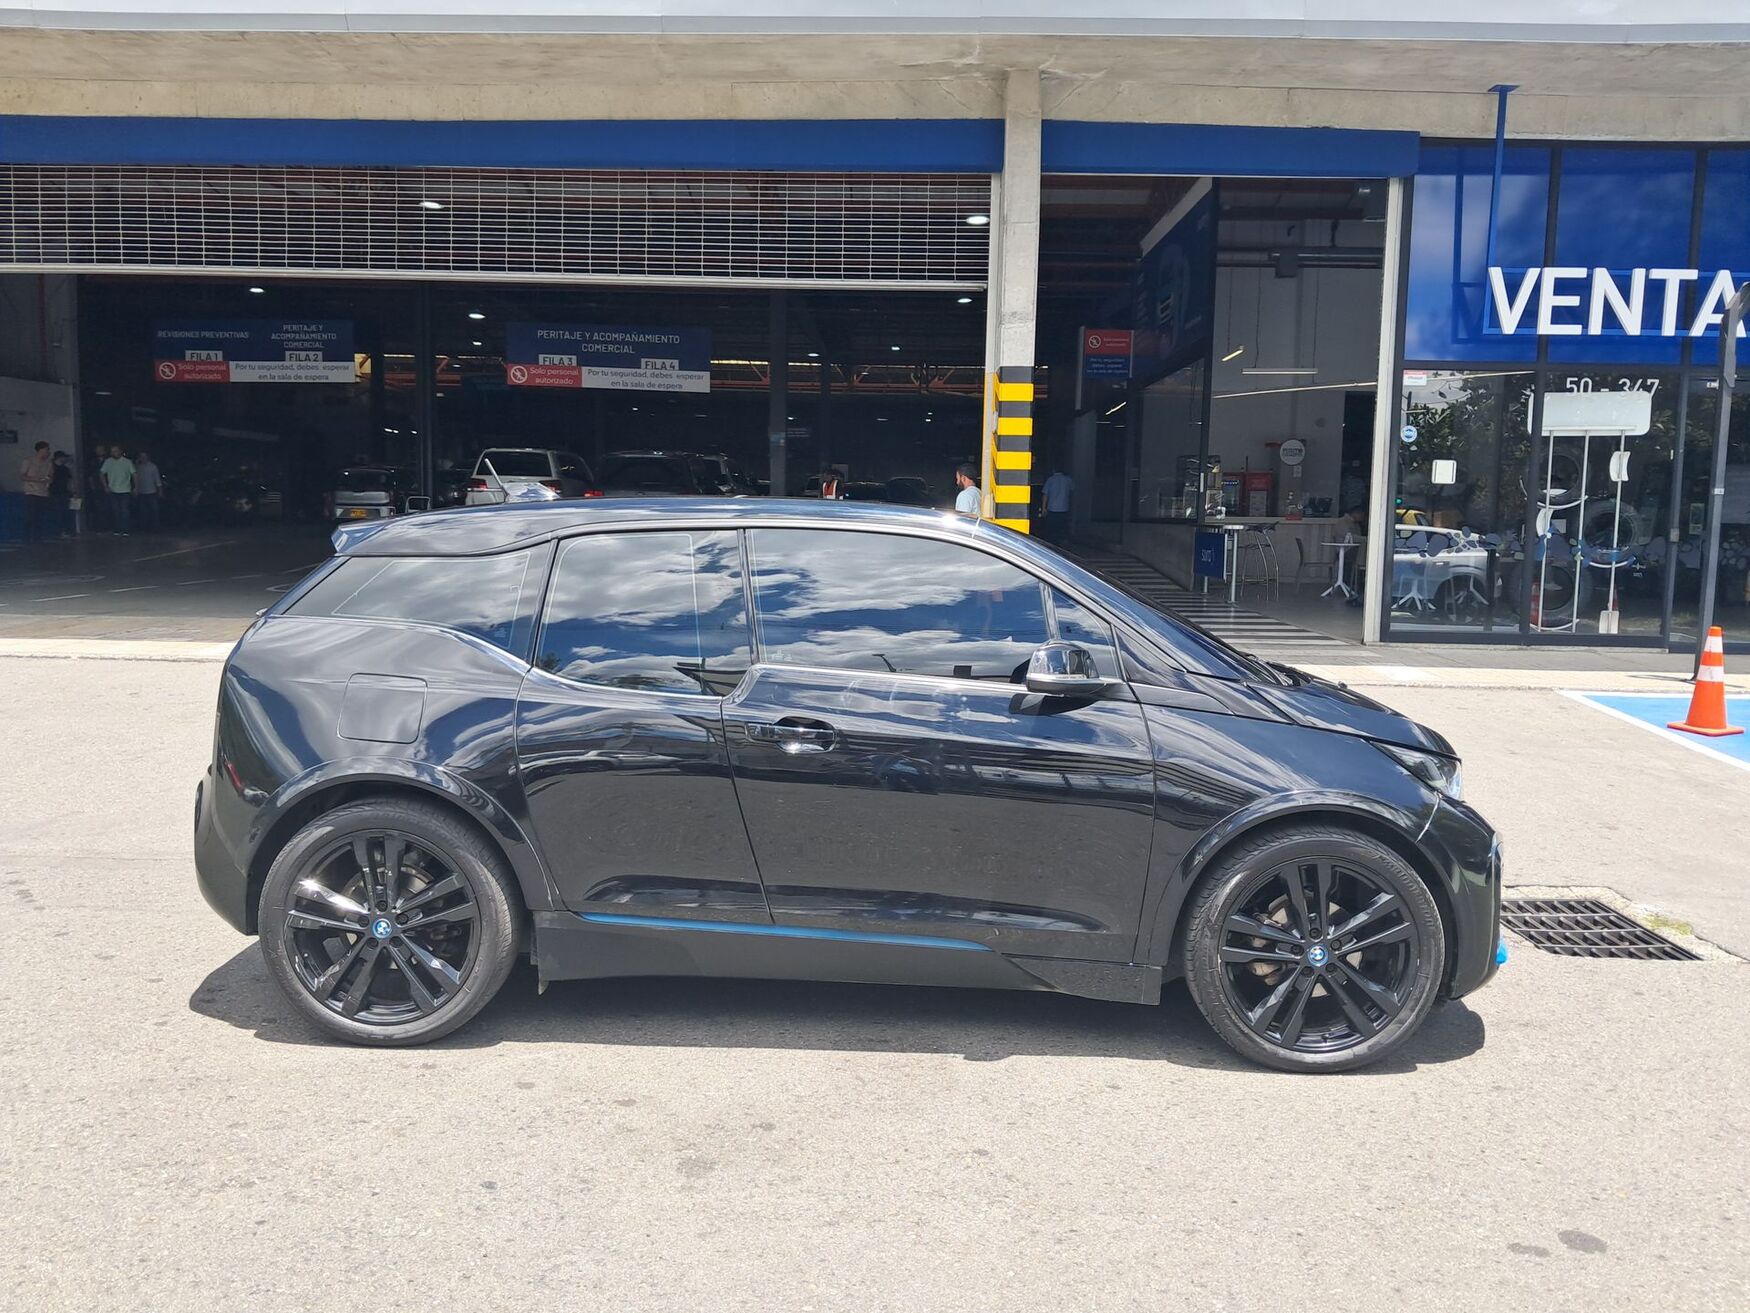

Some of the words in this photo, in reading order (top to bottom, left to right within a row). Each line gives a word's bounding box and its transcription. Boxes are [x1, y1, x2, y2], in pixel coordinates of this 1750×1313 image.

[1488, 267, 1747, 337] VENTA
[157, 330, 200, 338] REVISIONES
[537, 329, 582, 341] PERITAJE
[584, 332, 591, 340] Y
[592, 331, 680, 344] ACOMPAÑAMIENTO
[581, 343, 636, 354] COMERCIAL
[190, 352, 212, 361] FILA
[214, 352, 218, 361] 1
[289, 353, 312, 362] FILA
[312, 353, 319, 362] 2
[542, 356, 565, 366] FILA
[567, 357, 573, 366] 3
[644, 360, 668, 370] FILA
[668, 361, 676, 370] 4
[547, 368, 579, 376] personal
[601, 369, 609, 377] tu
[650, 371, 673, 379] debes
[676, 373, 704, 381] esperar
[535, 377, 574, 385] autorizado
[622, 379, 629, 387] la
[630, 380, 645, 388] sala
[646, 380, 656, 388] de
[657, 382, 683, 390] espera
